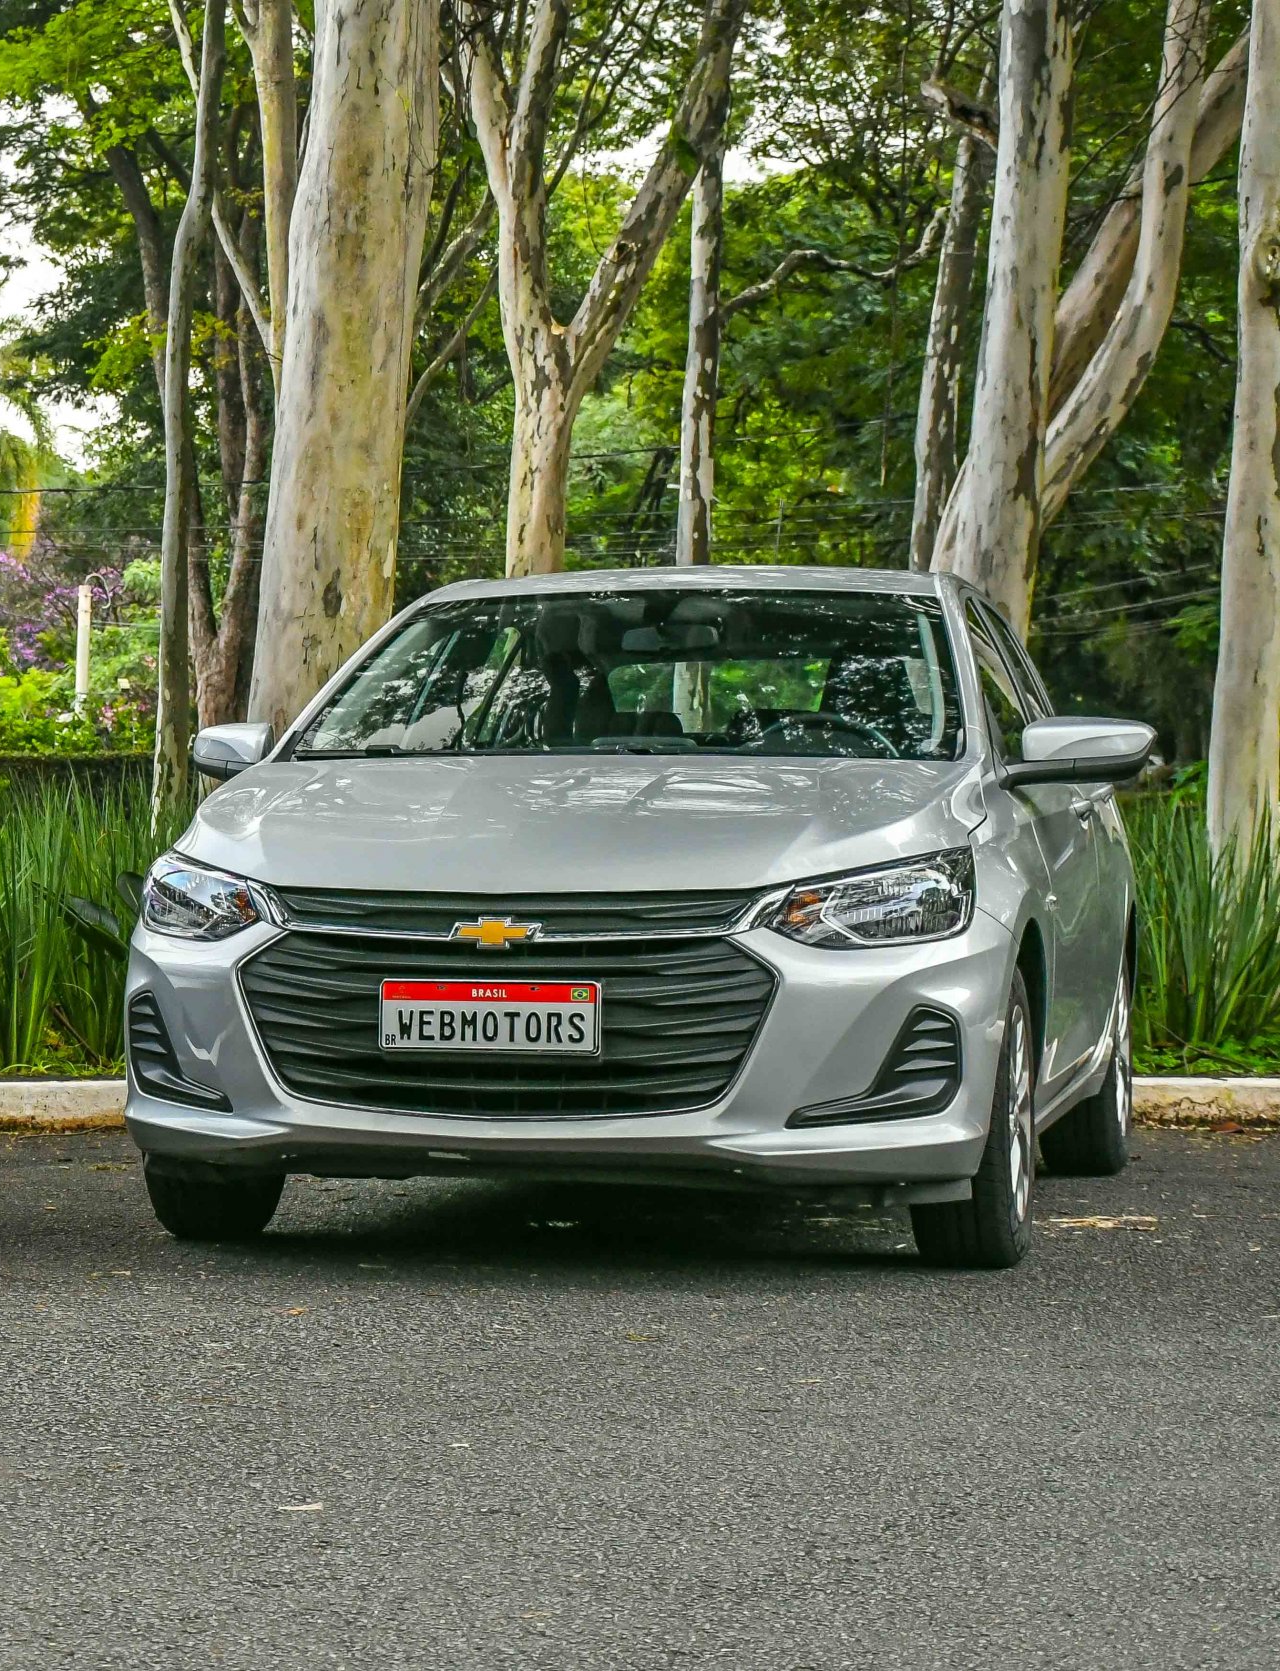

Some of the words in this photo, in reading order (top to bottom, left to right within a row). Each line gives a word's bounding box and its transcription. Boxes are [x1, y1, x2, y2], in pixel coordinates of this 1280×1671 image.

[471, 988, 508, 998] BRASIL
[397, 1009, 585, 1044] WEBMOTORS
[384, 1033, 397, 1046] BR
